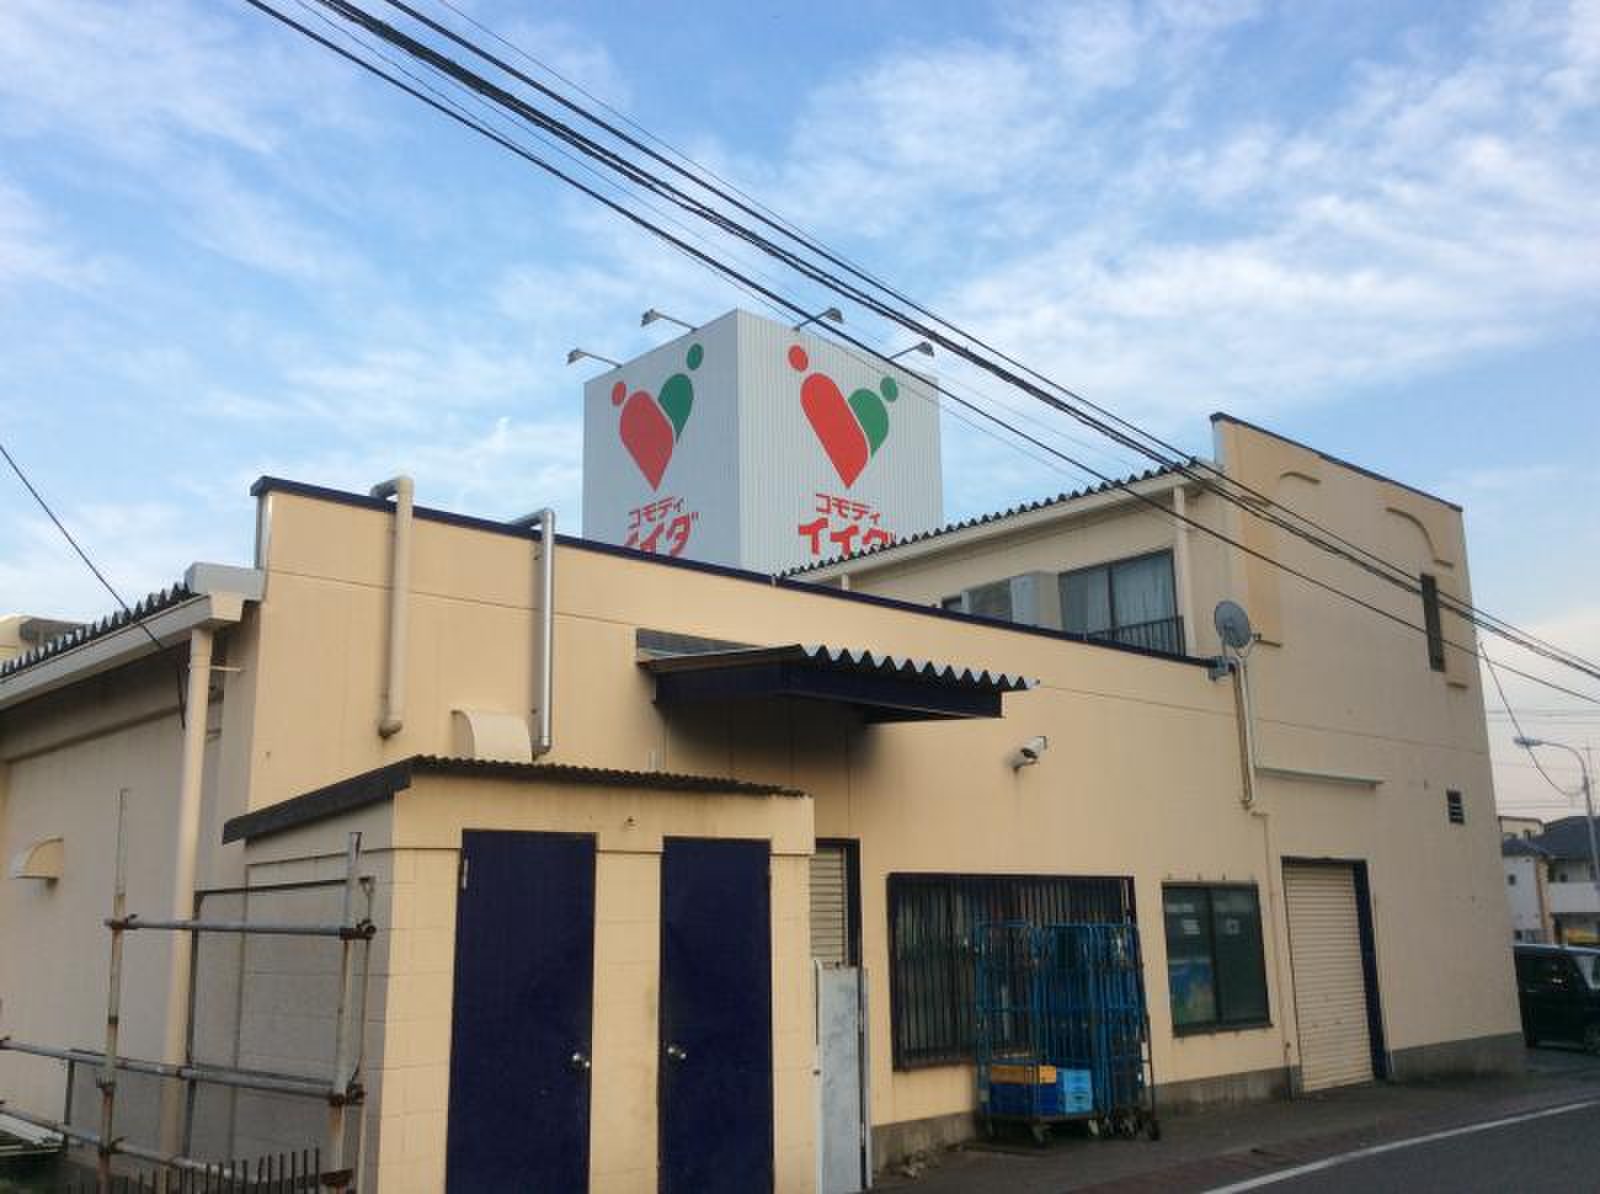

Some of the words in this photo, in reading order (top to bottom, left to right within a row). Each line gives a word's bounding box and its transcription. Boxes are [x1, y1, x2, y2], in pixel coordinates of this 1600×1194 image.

[628, 496, 684, 529] コモディ
[815, 493, 880, 525] コモディ
